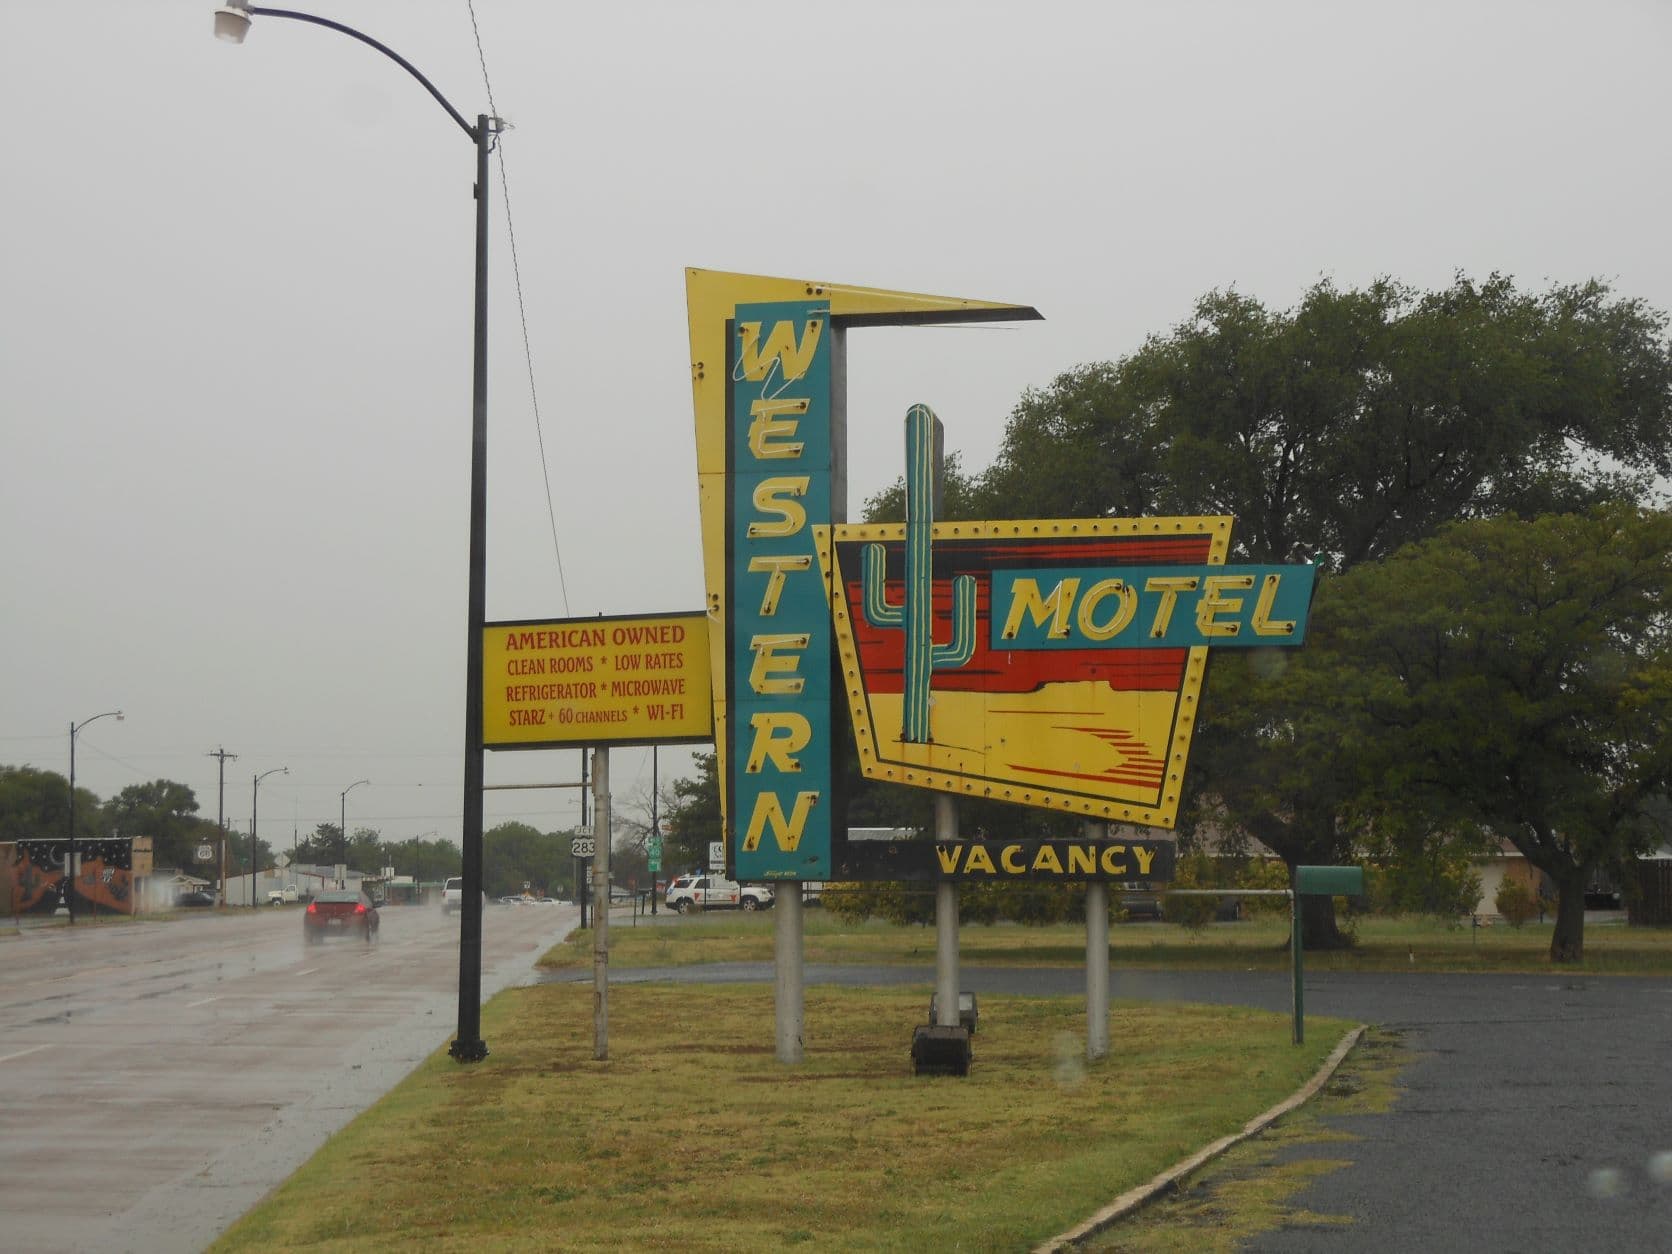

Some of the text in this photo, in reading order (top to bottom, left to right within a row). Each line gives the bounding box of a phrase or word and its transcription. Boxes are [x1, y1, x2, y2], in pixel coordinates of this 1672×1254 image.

[739, 319, 824, 852] WESTERN
[1001, 574, 1297, 641] MOTEL
[506, 625, 686, 650] AMERICAN OWNED
[507, 652, 684, 676] CLEAN ROOMS LOW RATES
[506, 678, 686, 702] REFRIGERATOR MICROWAVE
[509, 704, 684, 726] STARZ 60 CHANNELS WI-FI
[573, 842, 596, 854] 283
[936, 845, 1156, 874] VACANCY
